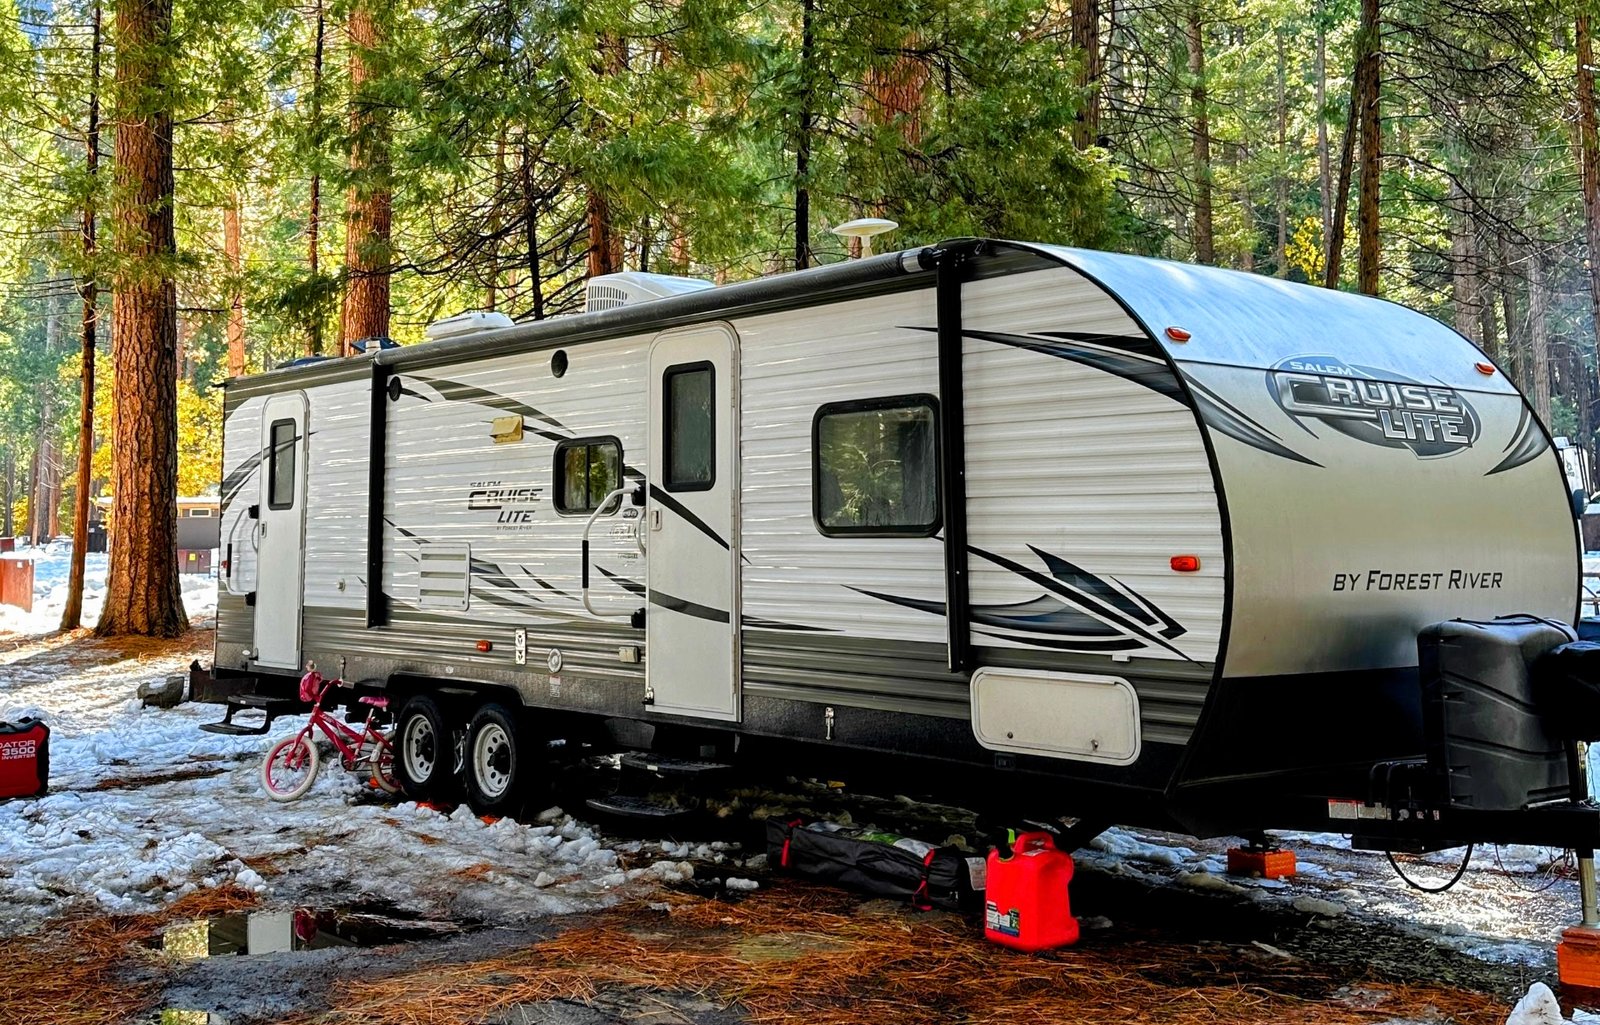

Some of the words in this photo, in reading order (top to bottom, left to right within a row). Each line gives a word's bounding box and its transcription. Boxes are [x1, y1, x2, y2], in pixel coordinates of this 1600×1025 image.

[1289, 361, 1353, 376] SALEM
[1275, 372, 1461, 420] CRUISE
[1379, 409, 1471, 445] LITE
[468, 488, 543, 510] CRUISE
[497, 510, 535, 523] LITE
[1333, 573, 1361, 591] BY
[1366, 570, 1443, 591] FOREST
[1448, 570, 1503, 590] RIVER
[2, 746, 36, 756] 3500
